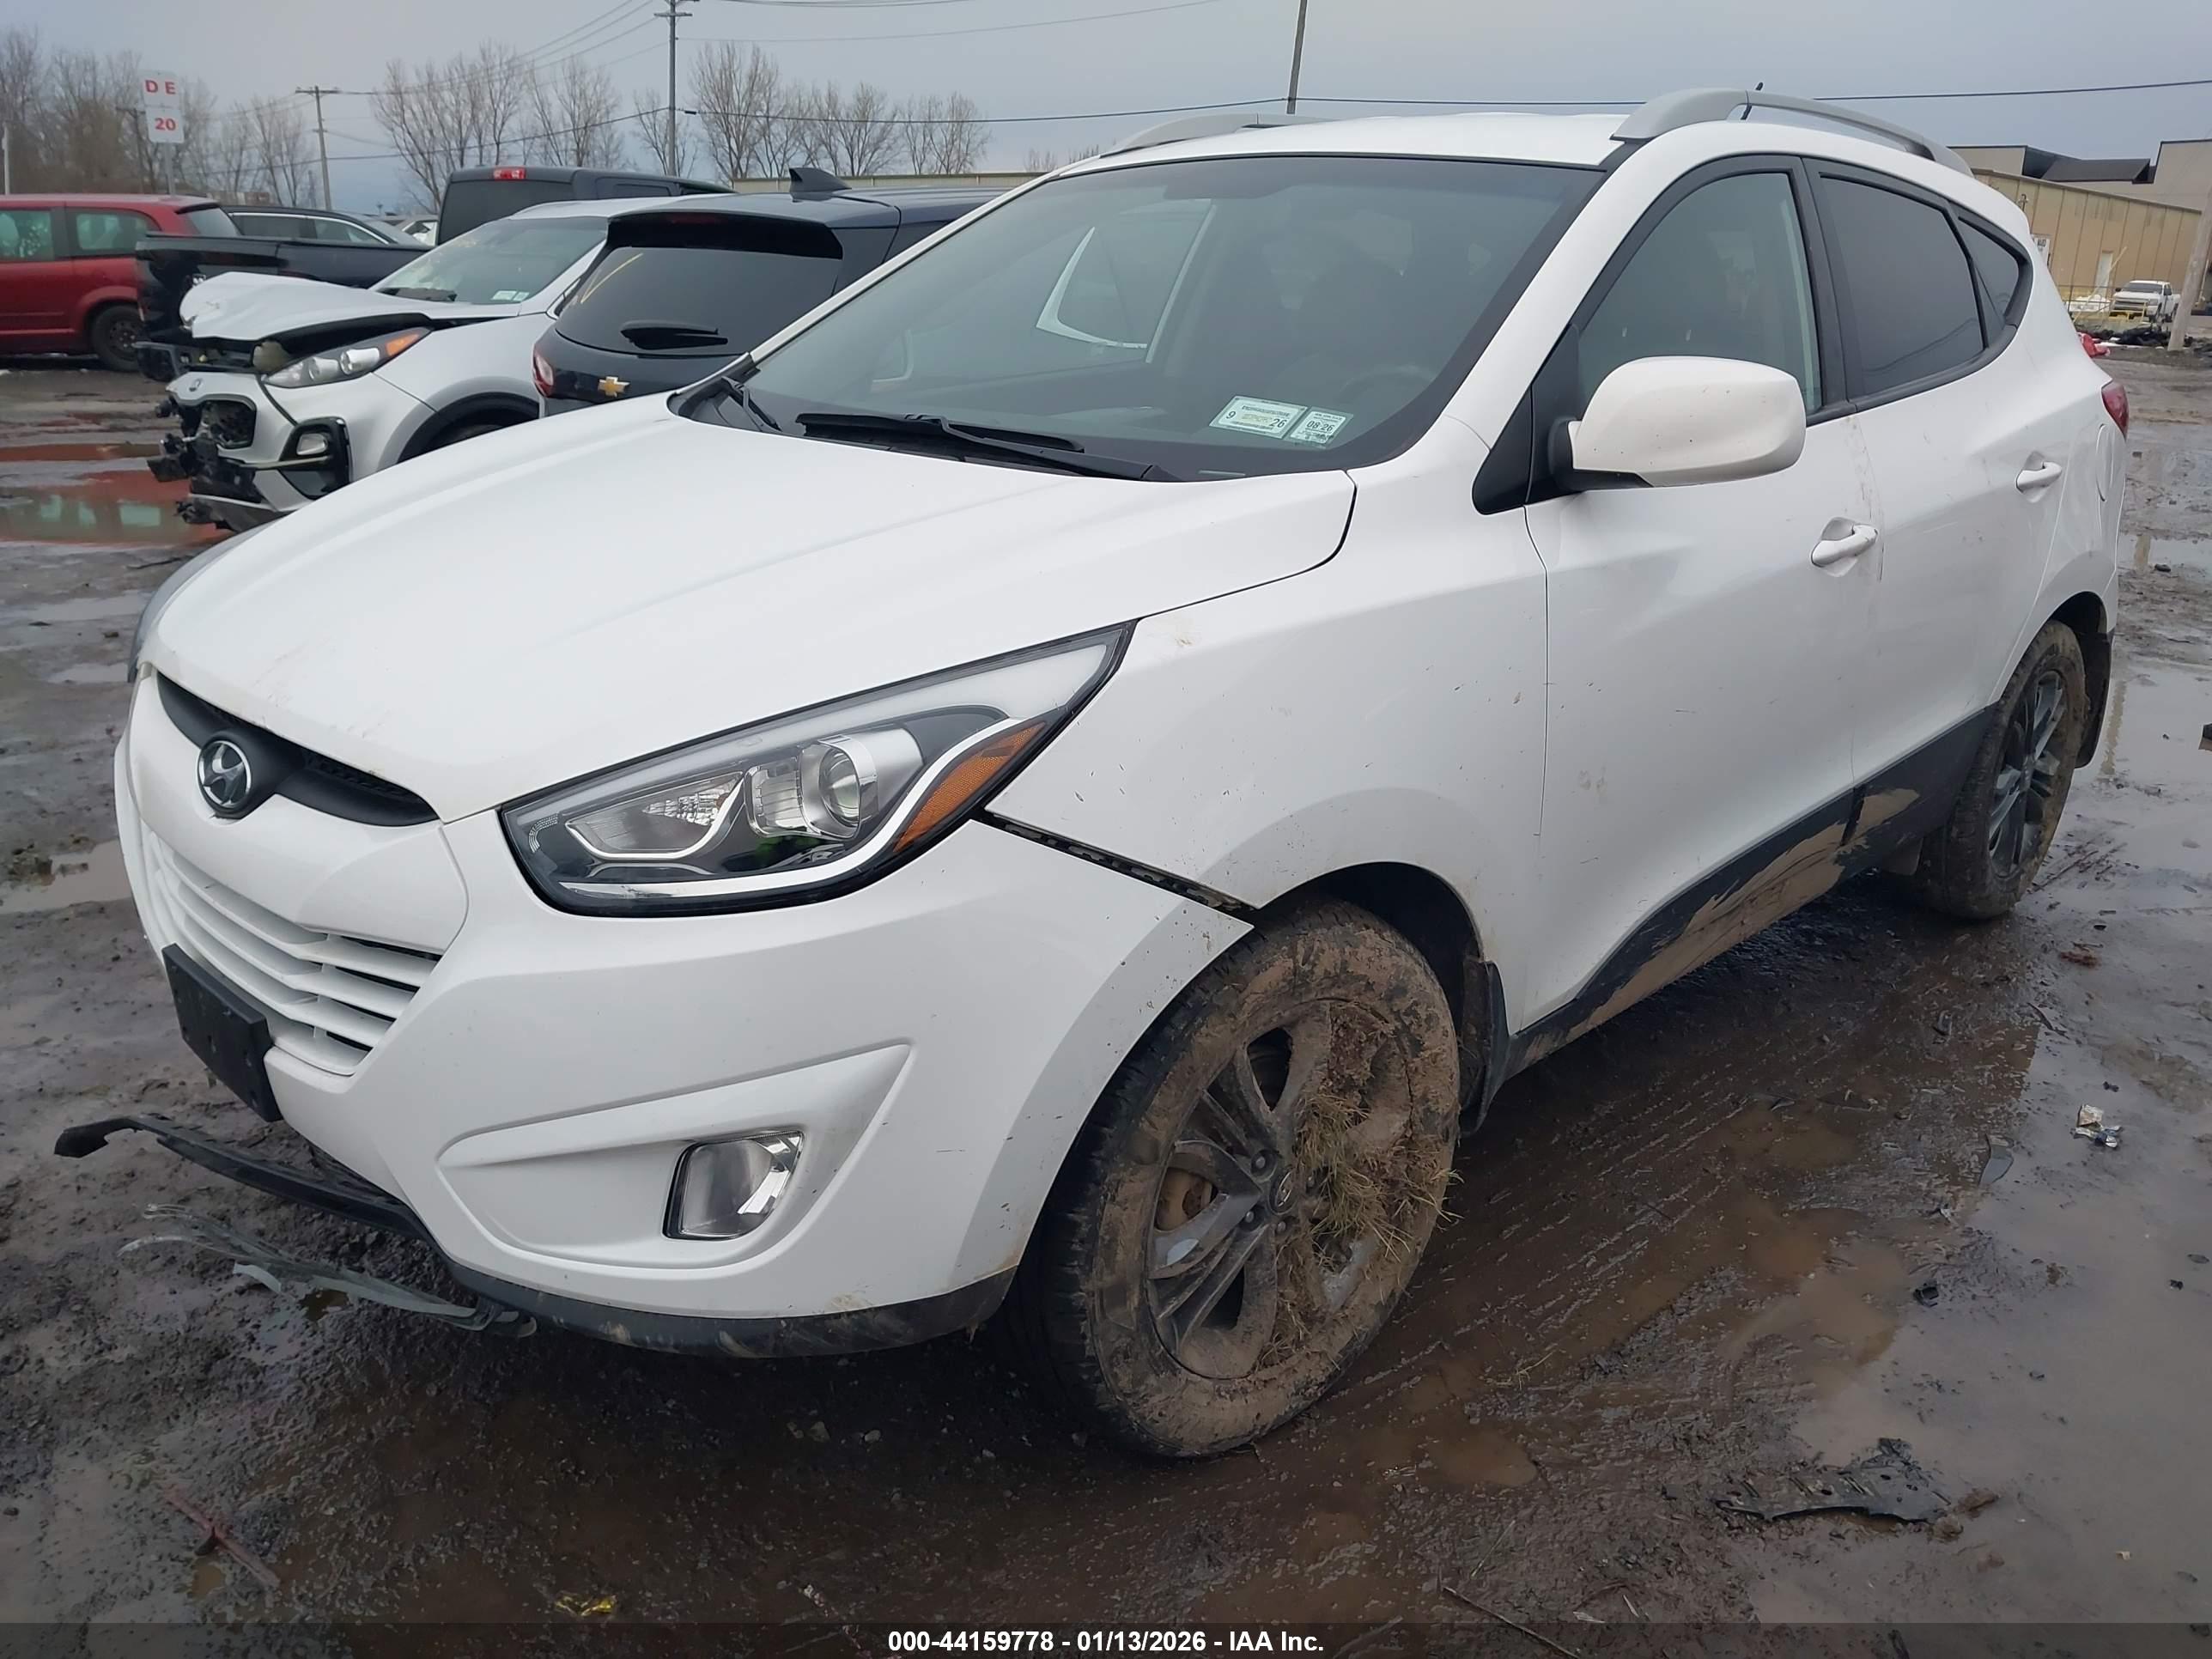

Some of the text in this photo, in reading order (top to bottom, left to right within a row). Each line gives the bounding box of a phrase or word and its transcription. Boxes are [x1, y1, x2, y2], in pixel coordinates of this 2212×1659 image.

[155, 117, 176, 131] 20
[1226, 410, 1237, 419] 9
[1269, 418, 1287, 428] 26
